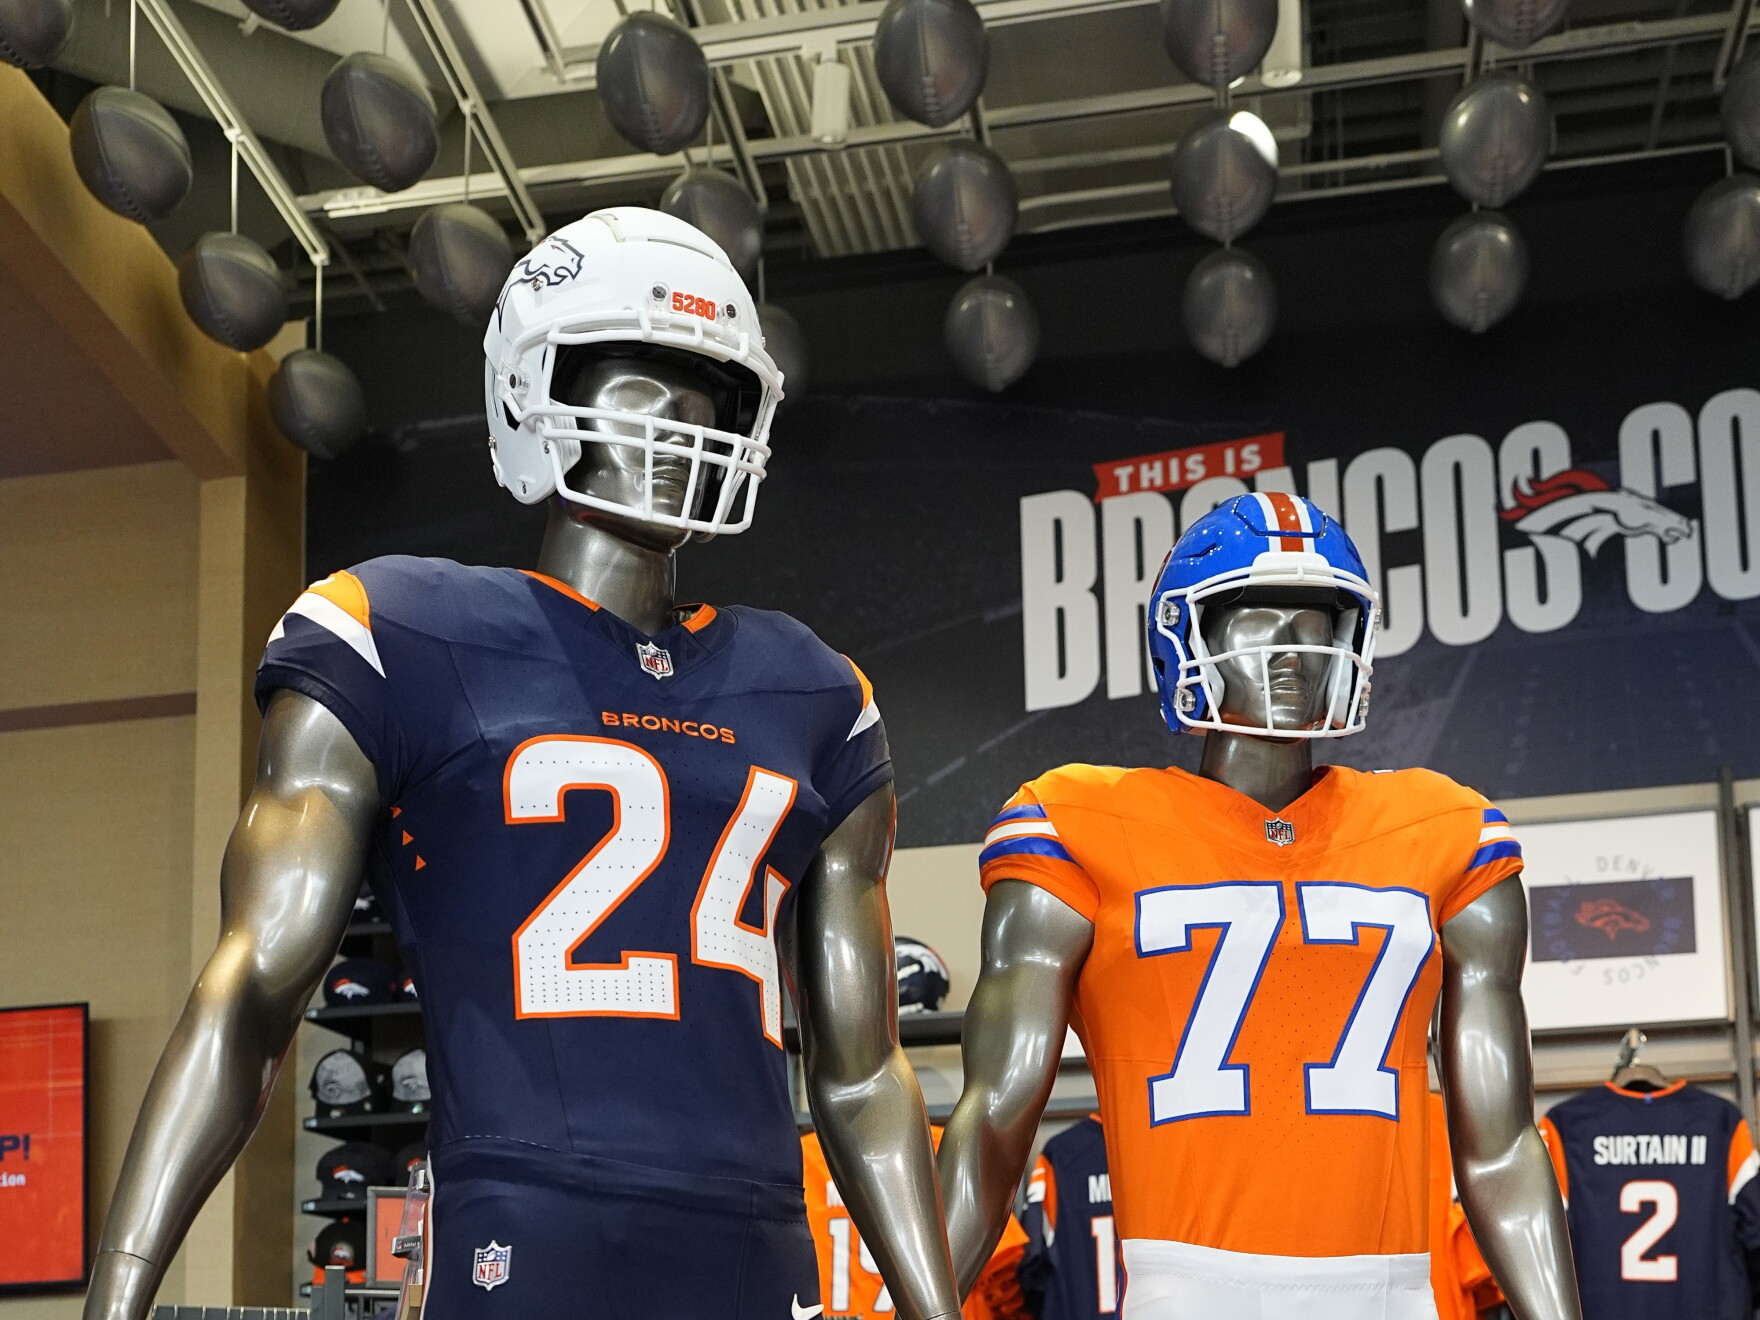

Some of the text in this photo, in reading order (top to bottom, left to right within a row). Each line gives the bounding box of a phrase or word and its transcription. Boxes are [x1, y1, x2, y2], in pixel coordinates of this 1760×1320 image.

[672, 291, 716, 320] 5280
[1113, 443, 1262, 493] THIS IS
[645, 656, 669, 671] NFL
[602, 710, 737, 745] BRONCOS
[1270, 829, 1291, 841] NFL
[503, 733, 798, 1051] 24
[1134, 880, 1437, 1129] 77
[1593, 1135, 1707, 1165] SURTAIN II
[1619, 1179, 1679, 1282] 2
[478, 1263, 502, 1281] NFL
